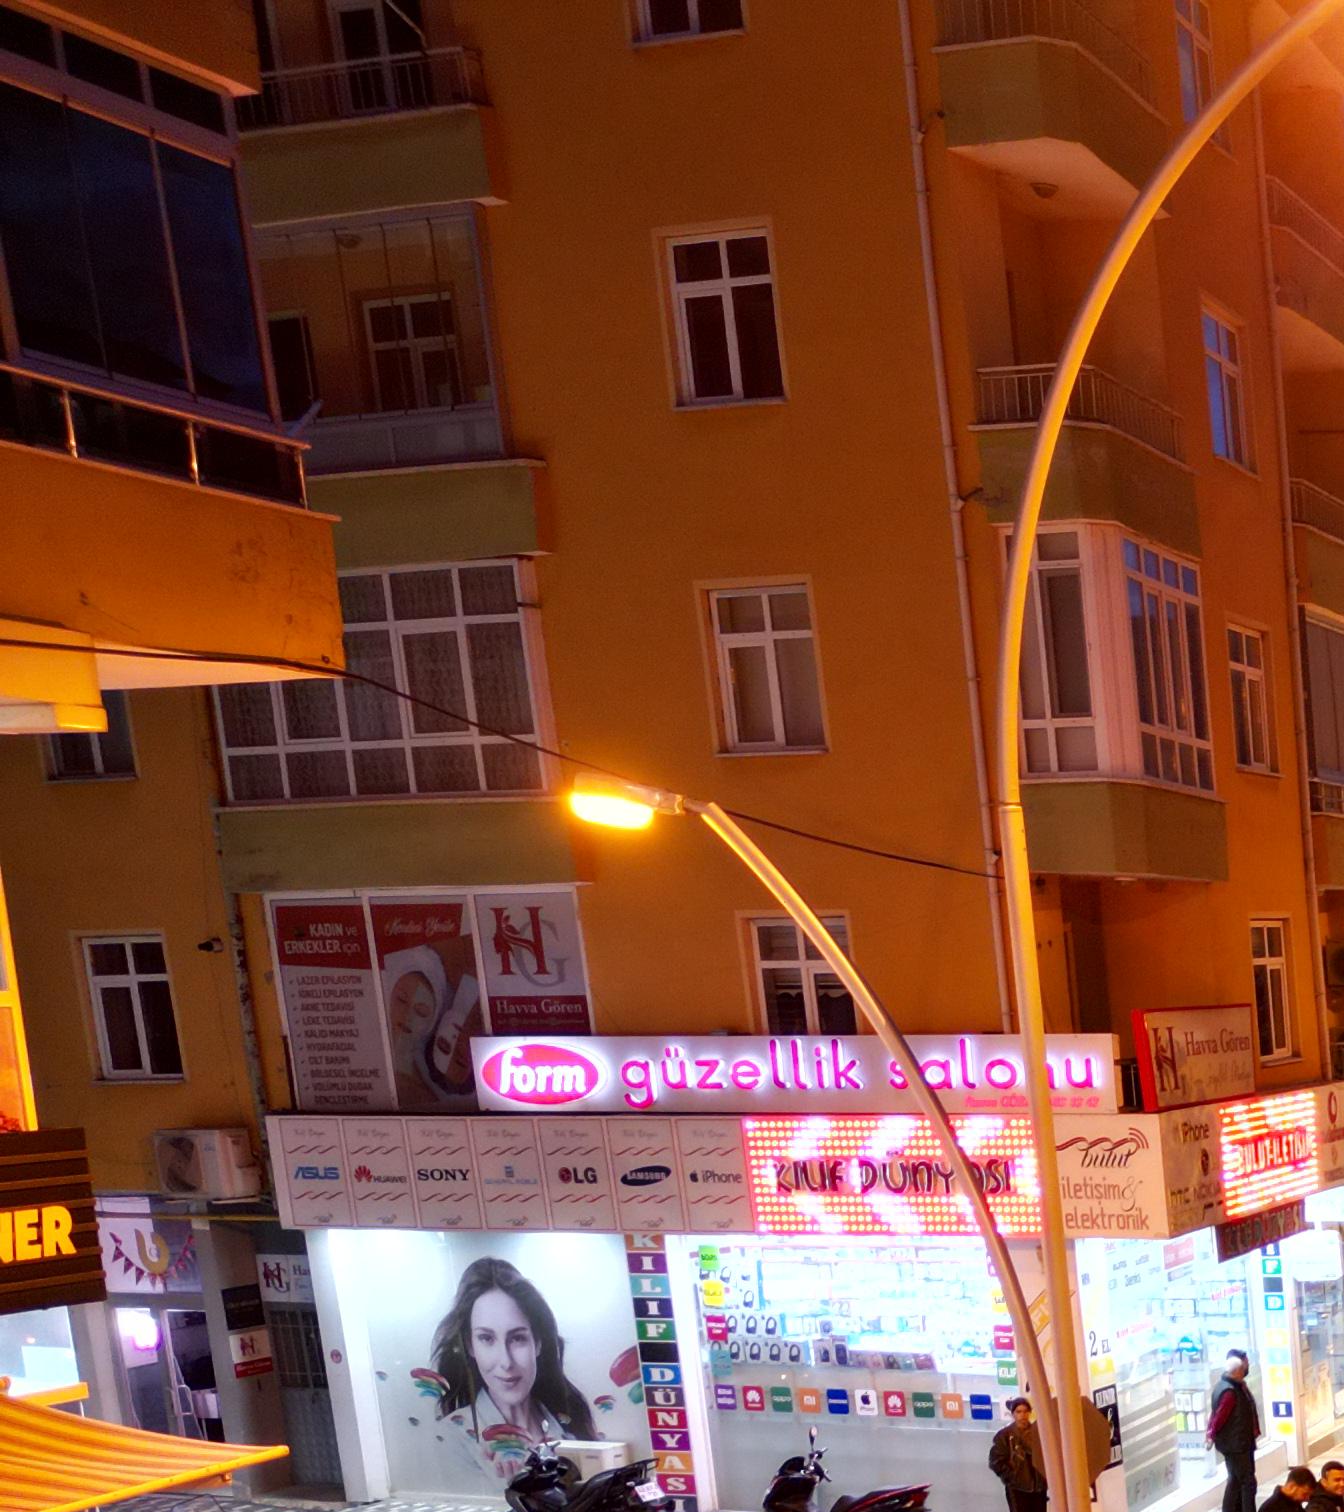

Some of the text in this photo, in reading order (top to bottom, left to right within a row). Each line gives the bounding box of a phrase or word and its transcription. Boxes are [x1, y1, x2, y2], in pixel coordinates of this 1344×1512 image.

[309, 922, 358, 937] KADIN ve
[284, 940, 341, 954] ERKEKLER
[496, 999, 582, 1014] Havva Gören
[500, 1047, 586, 1095] form
[620, 1039, 863, 1109] güzellik
[1080, 1148, 1132, 1168] bulut
[293, 1166, 340, 1181] ASUS
[372, 1175, 408, 1184] HUAWEI
[416, 1168, 470, 1182] SONY
[573, 1167, 598, 1184] LG
[701, 1170, 743, 1184] iPhone
[1061, 1176, 1121, 1206] iletişim
[1064, 1206, 1150, 1231] elektronik
